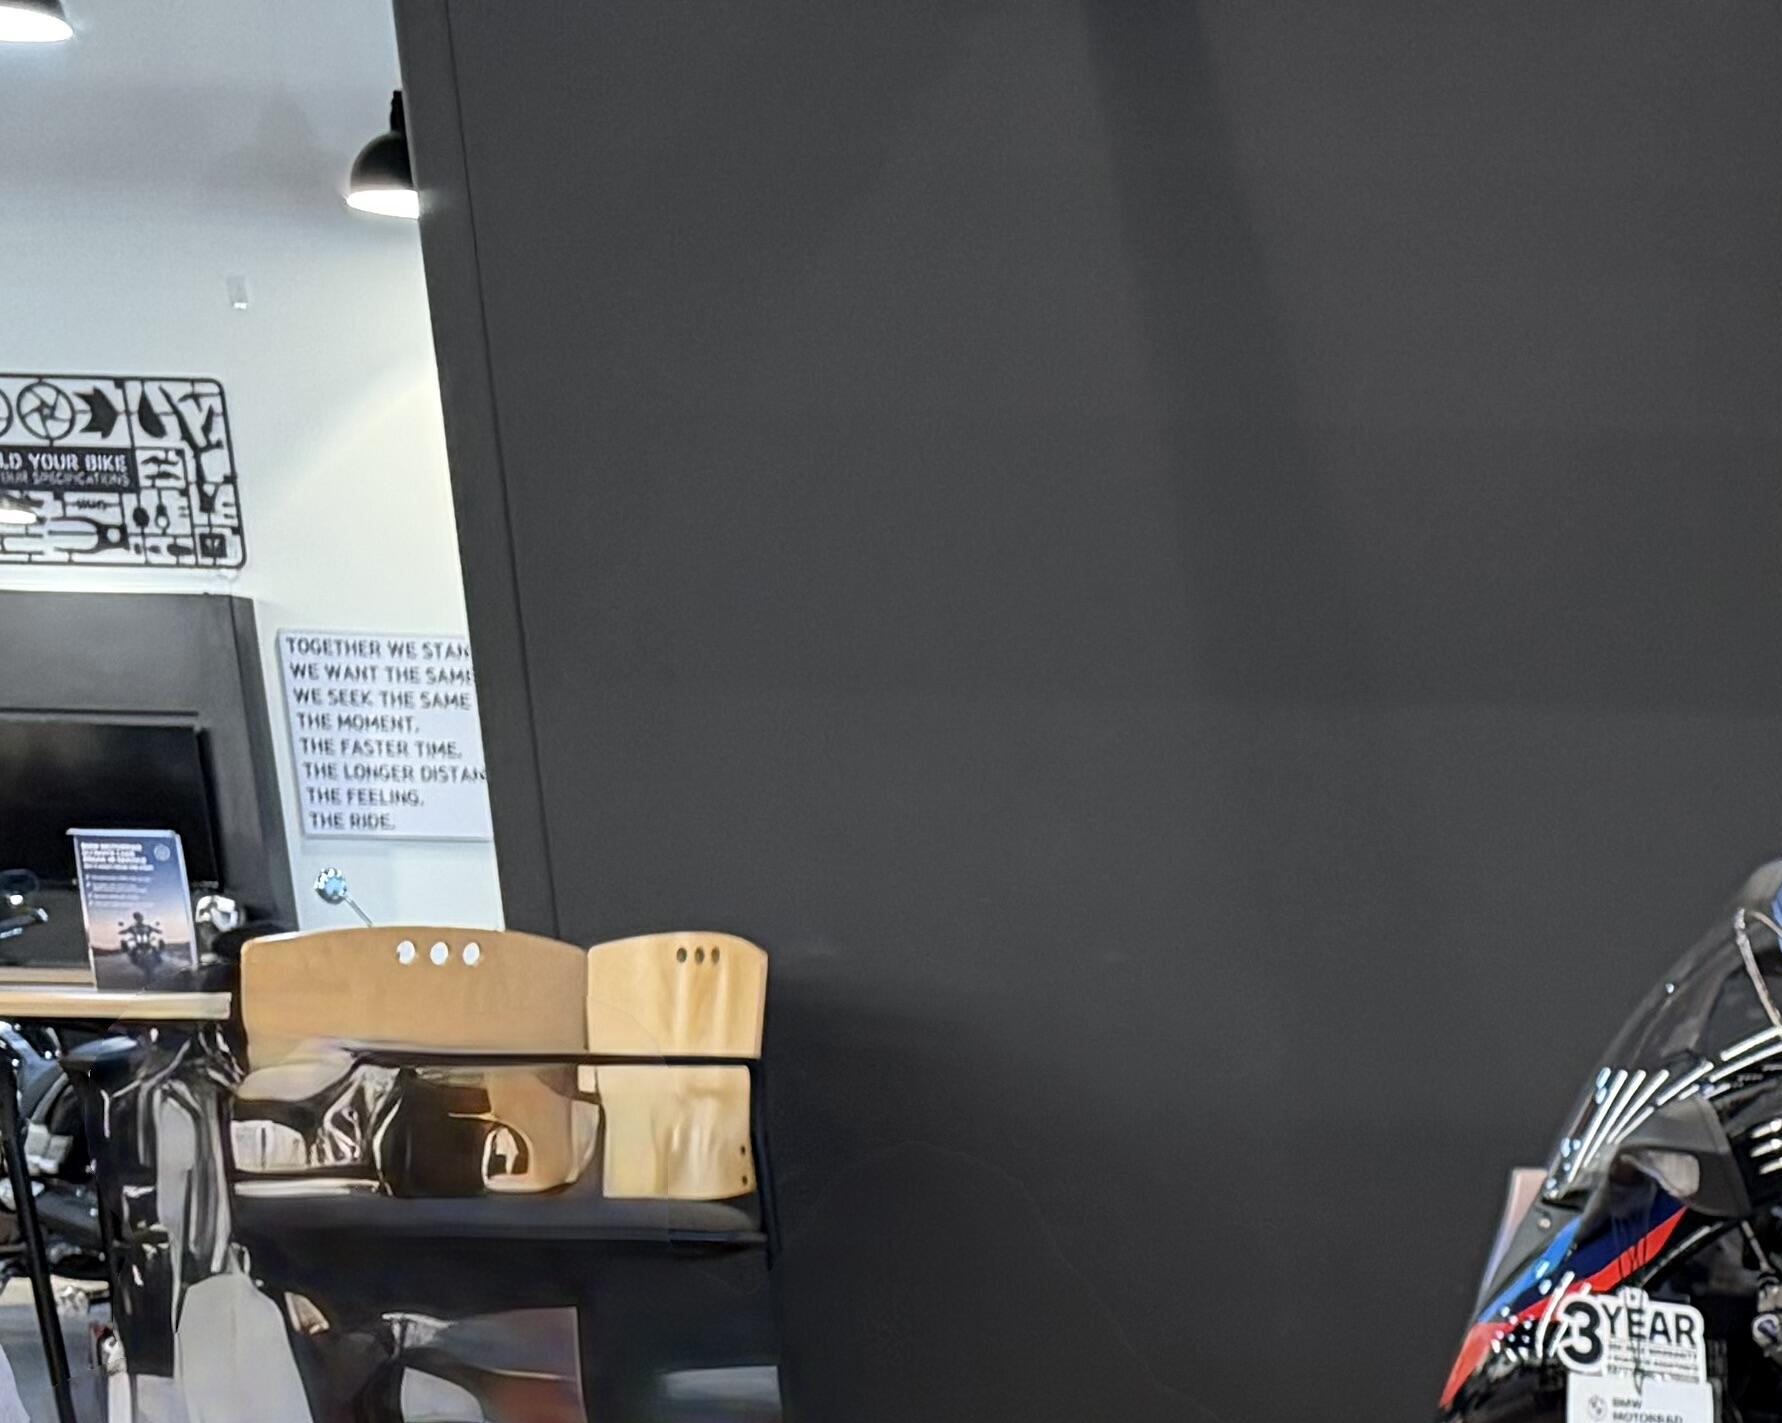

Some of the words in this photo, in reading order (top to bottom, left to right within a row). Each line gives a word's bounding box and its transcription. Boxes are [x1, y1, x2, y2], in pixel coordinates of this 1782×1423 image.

[28, 453, 79, 472] YOUR
[85, 453, 127, 472] BIKE
[286, 637, 381, 658] TOGETHER
[387, 639, 418, 659] WE
[290, 662, 319, 681] WE
[325, 664, 378, 683] WANT
[385, 665, 419, 684] THE
[293, 687, 323, 706] WE
[328, 688, 374, 708] SEEK
[380, 690, 415, 709] THE
[421, 691, 471, 711] SAME
[297, 712, 333, 731] THE
[338, 713, 420, 733] MOMENT.
[301, 737, 336, 756] THE
[342, 738, 409, 757] FASTER
[304, 761, 338, 780] THE
[344, 763, 414, 782] LONGER
[307, 786, 341, 805] THE
[346, 788, 424, 807] FEELING.
[309, 810, 345, 830] THE
[350, 811, 396, 831] RIDE.
[1562, 1301, 1604, 1365] 3
[1605, 1307, 1697, 1347] YEAR
